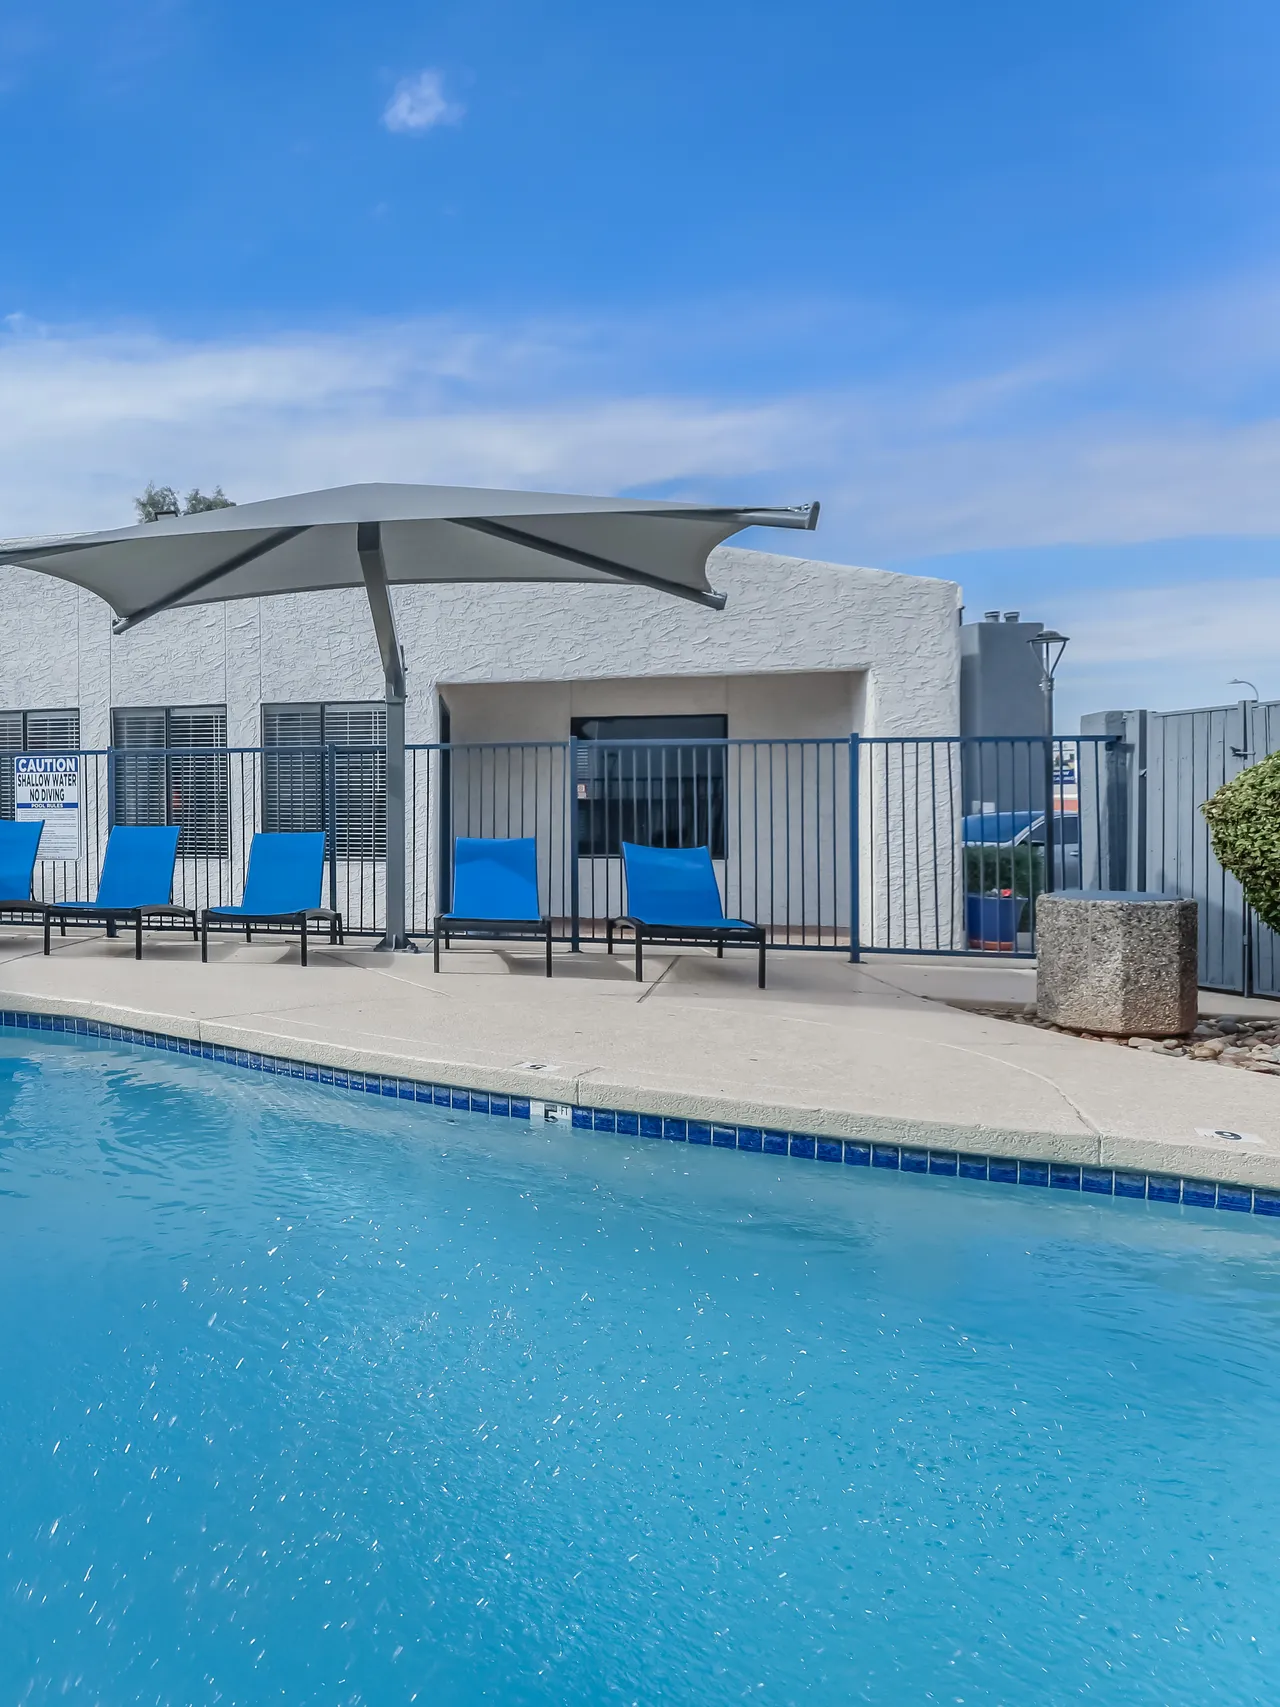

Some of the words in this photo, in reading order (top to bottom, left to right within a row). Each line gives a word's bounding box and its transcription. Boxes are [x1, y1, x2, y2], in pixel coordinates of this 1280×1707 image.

[18, 758, 76, 772] CAUTION
[18, 773, 51, 787] SHALLOW
[52, 773, 77, 787] WATER
[29, 788, 40, 801] NO
[41, 788, 65, 801] DIVING
[544, 1104, 558, 1123] 5
[560, 1105, 569, 1116] FT
